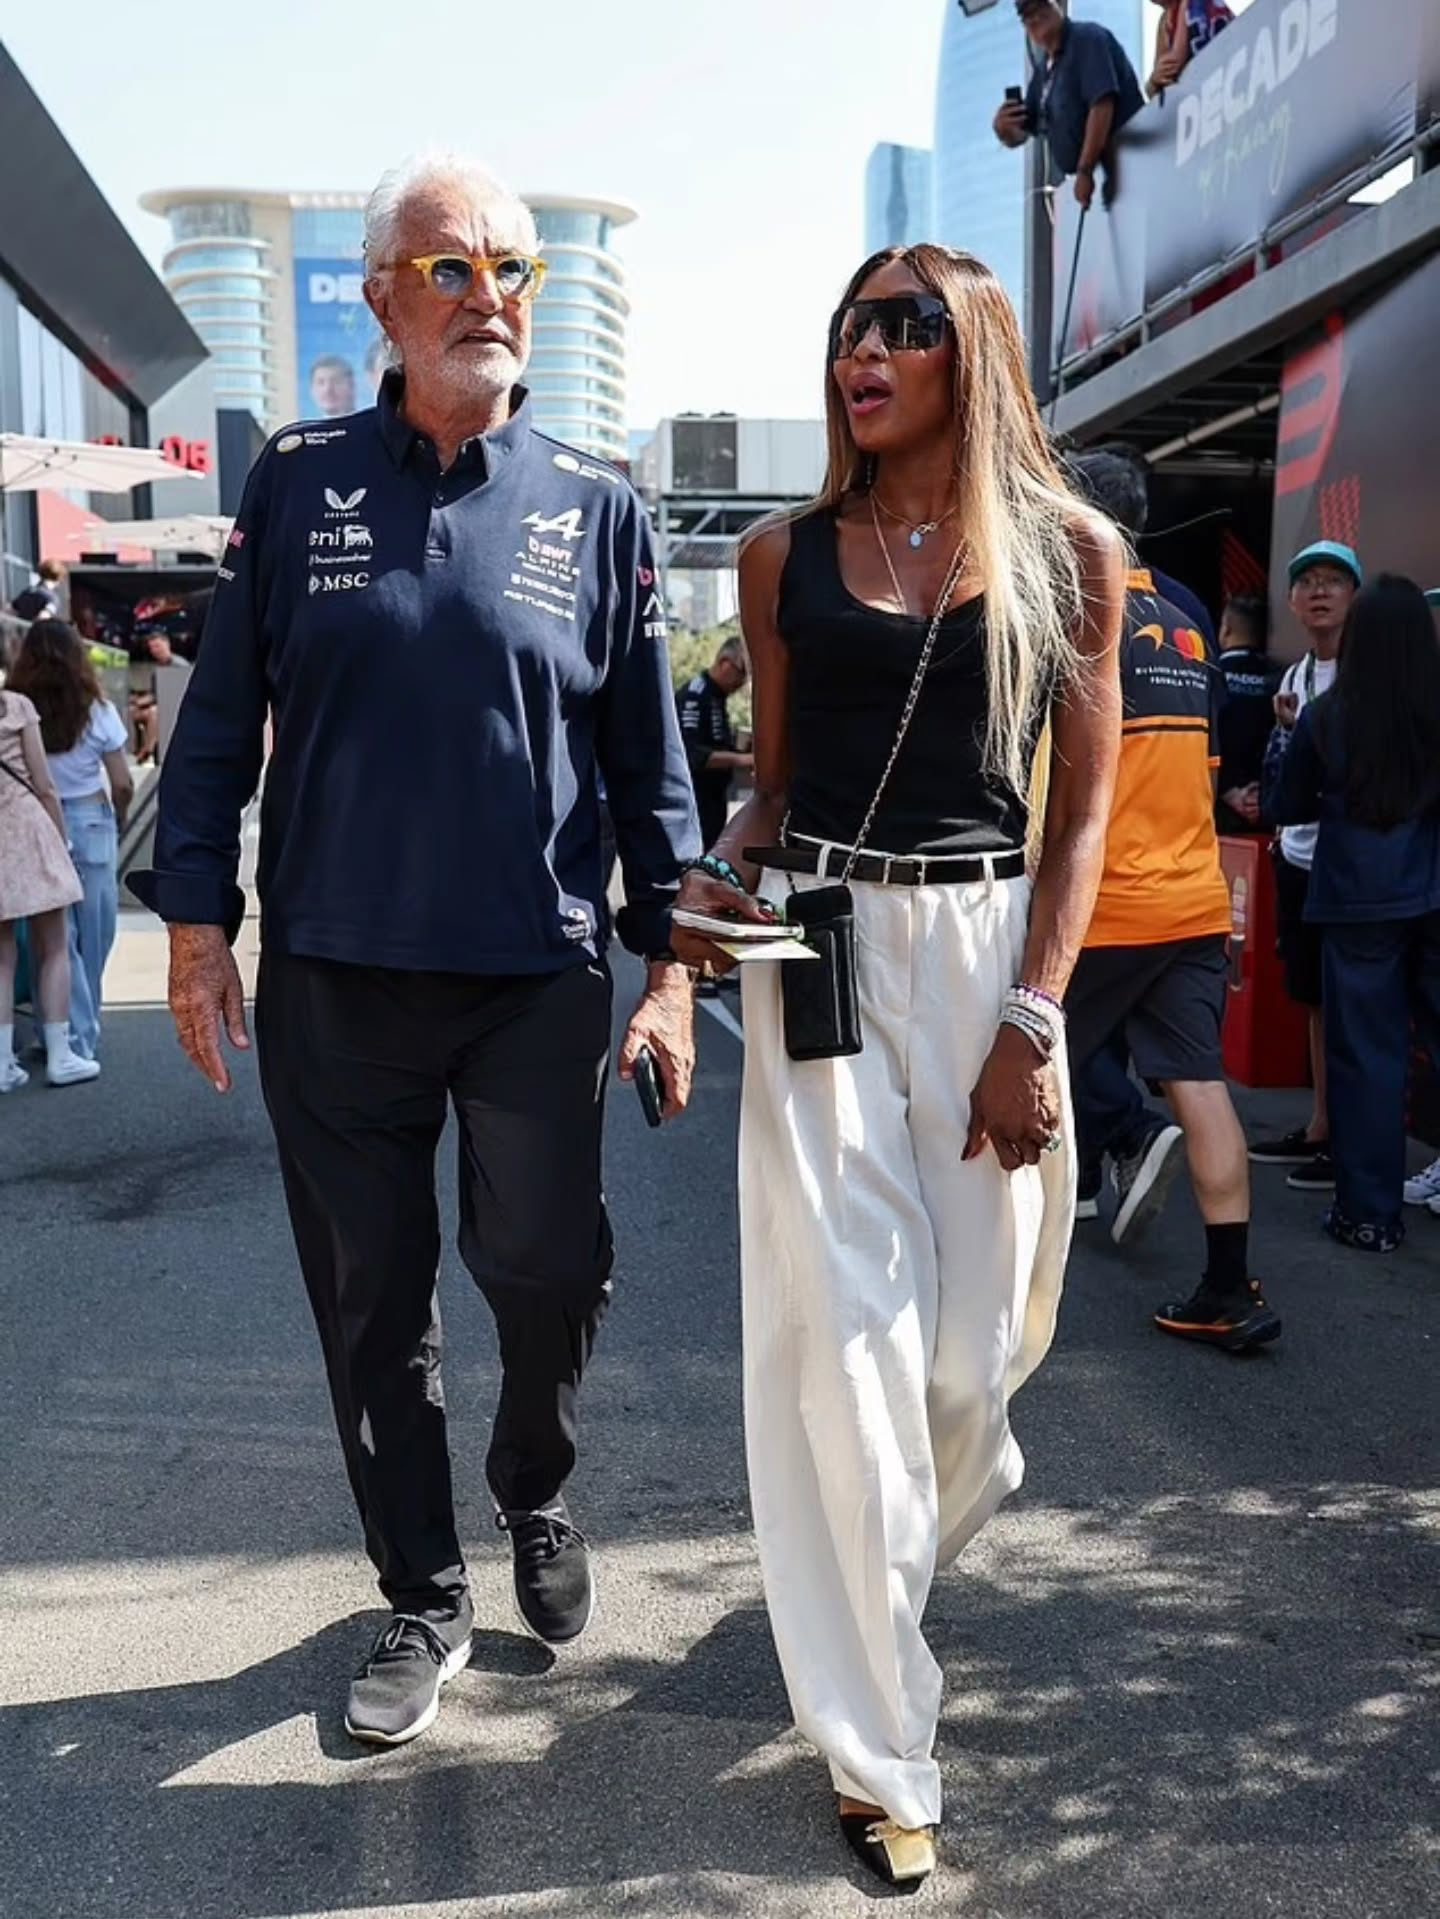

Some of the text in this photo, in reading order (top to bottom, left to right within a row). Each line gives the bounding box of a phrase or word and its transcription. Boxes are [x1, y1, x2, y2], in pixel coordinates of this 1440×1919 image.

[1175, 0, 1338, 169] DECADE
[308, 526, 342, 547] eni
[322, 571, 370, 592] MSC
